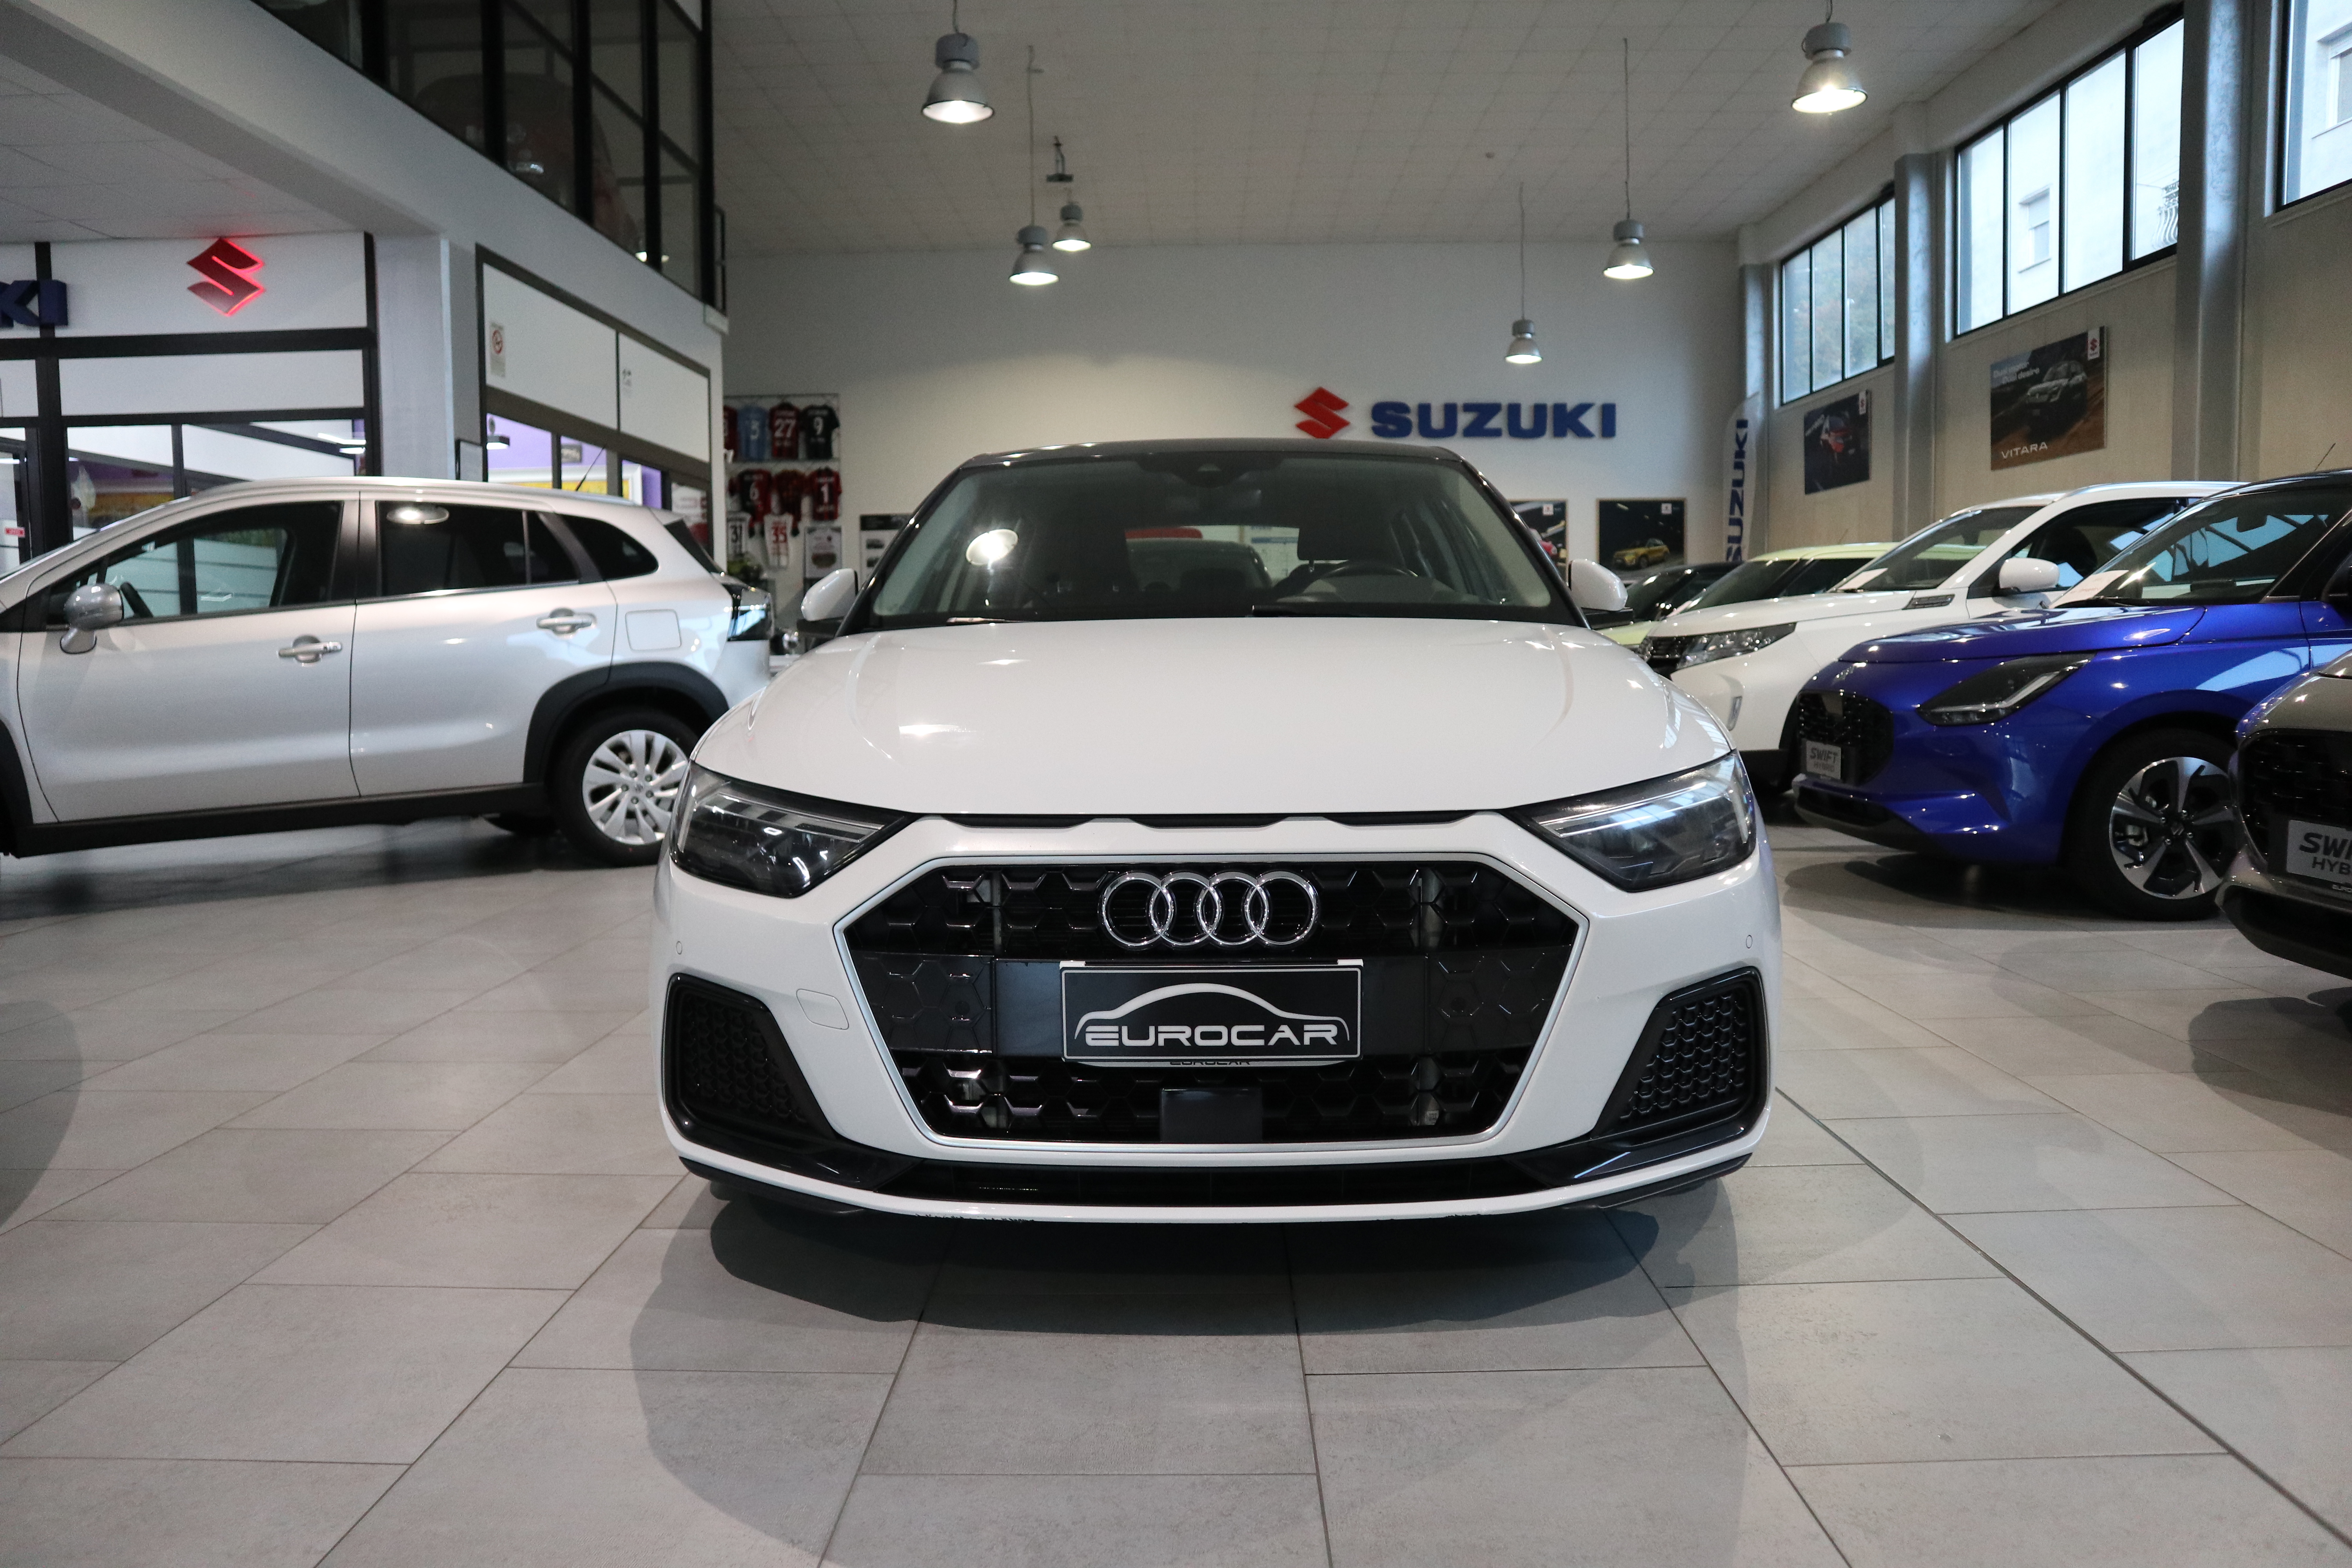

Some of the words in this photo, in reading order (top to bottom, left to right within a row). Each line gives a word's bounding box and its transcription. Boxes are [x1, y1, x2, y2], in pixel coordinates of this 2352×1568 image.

[774, 418, 796, 438] 27
[813, 416, 823, 436] 9
[1371, 401, 1617, 439] SUZUKI
[2001, 441, 2047, 459] VITARA
[750, 481, 759, 501] 6
[821, 483, 829, 503] 1
[772, 526, 787, 544] 35
[1810, 747, 1838, 764] SWIFT
[1085, 1024, 1338, 1046] EUROCAR
